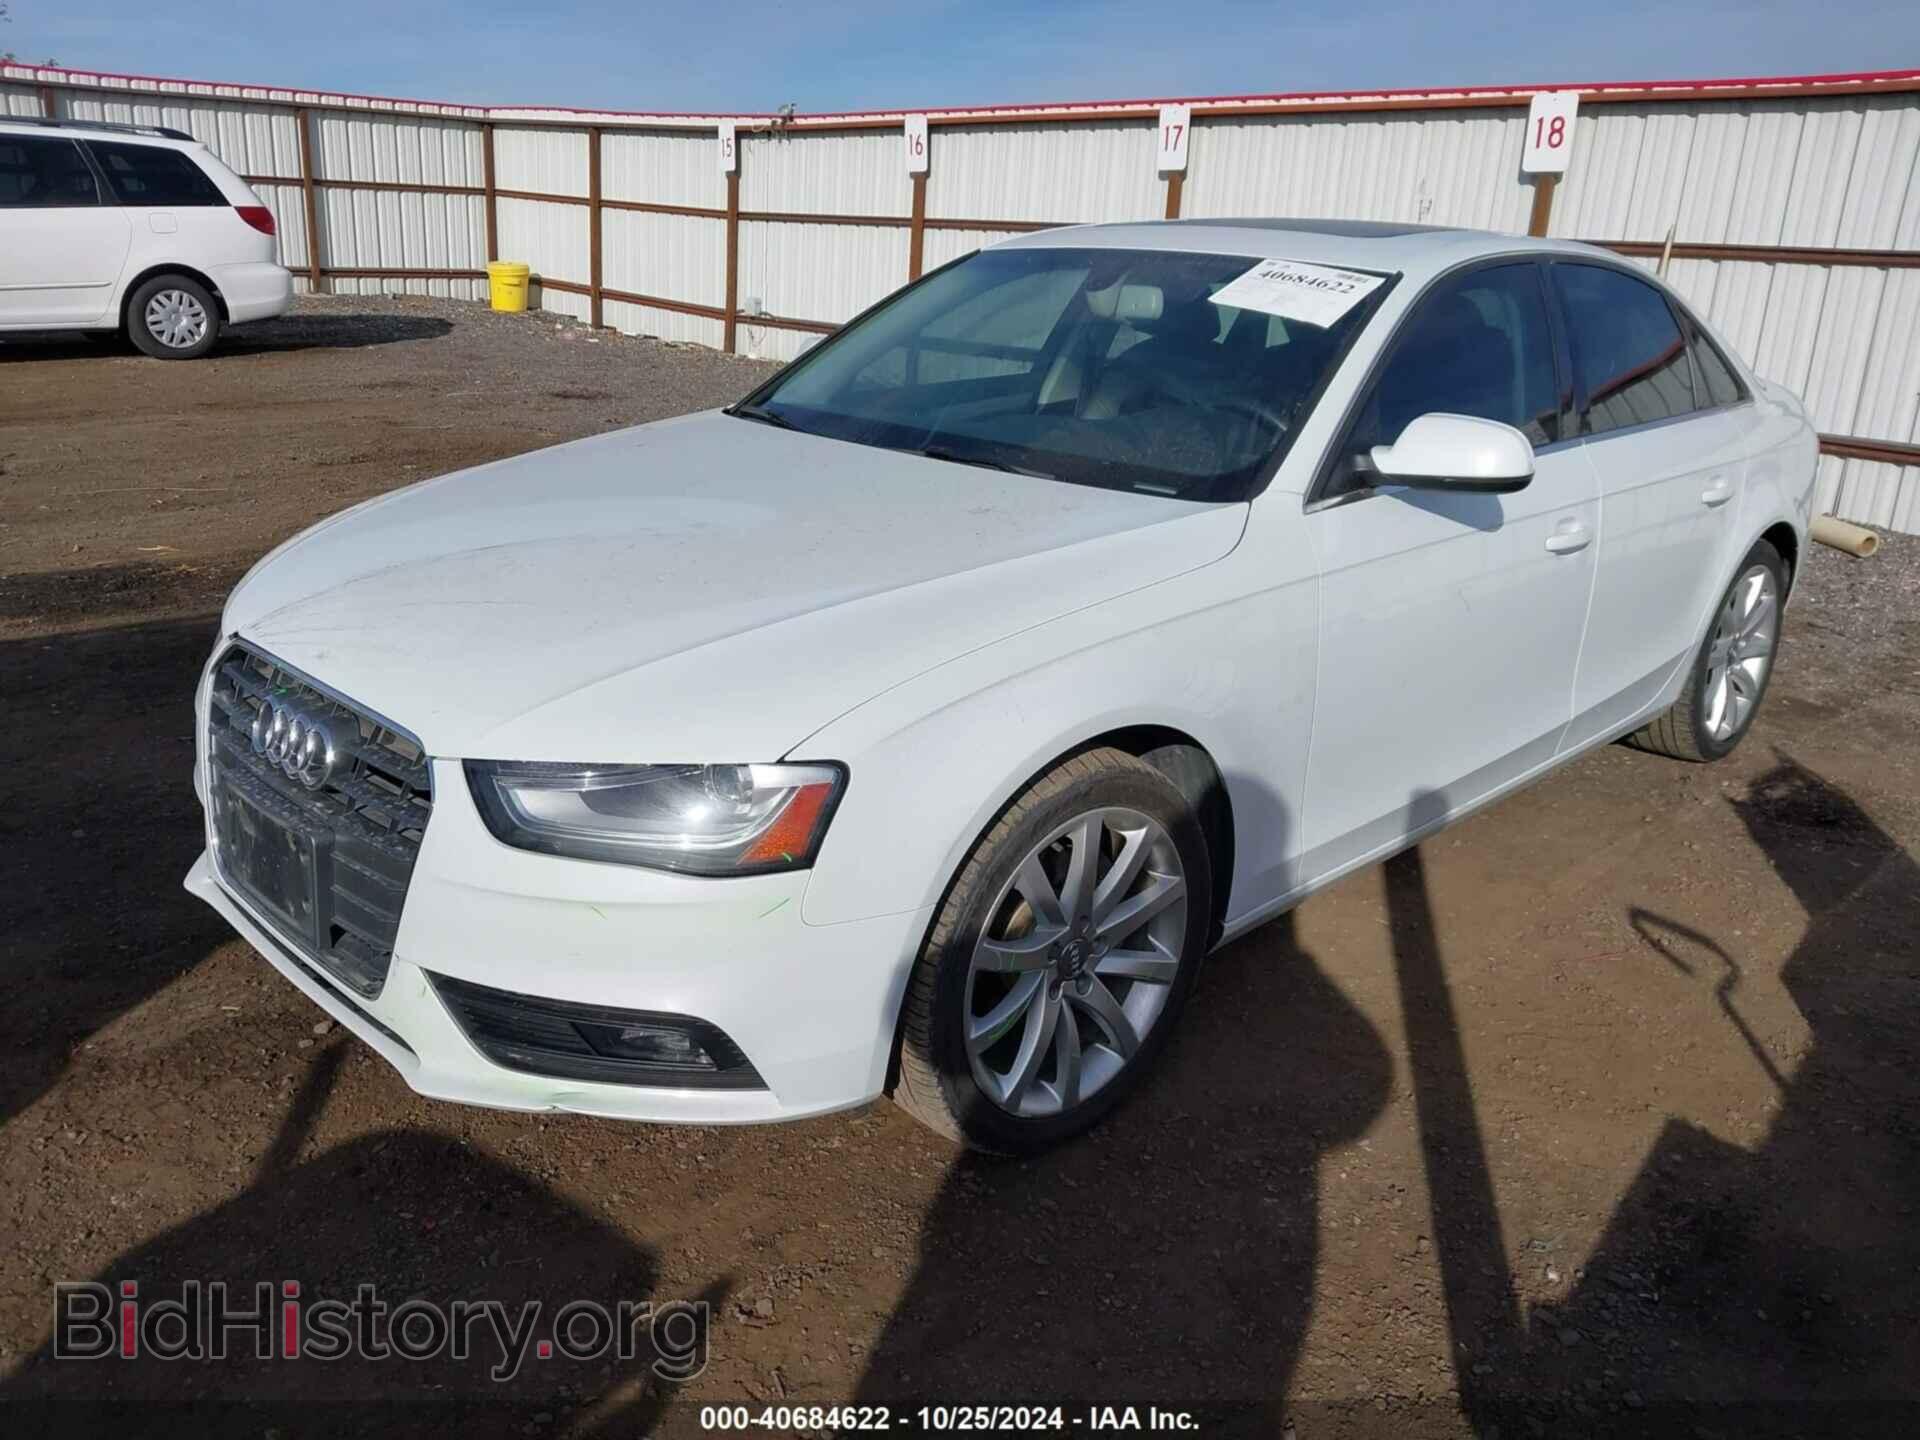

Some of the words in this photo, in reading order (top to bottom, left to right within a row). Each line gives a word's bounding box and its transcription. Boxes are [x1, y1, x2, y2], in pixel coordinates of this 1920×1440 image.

[1164, 125, 1184, 152] 17
[1535, 115, 1566, 149] 18
[721, 137, 733, 158] 15
[908, 133, 924, 156] 16
[1258, 270, 1356, 294] 40684622
